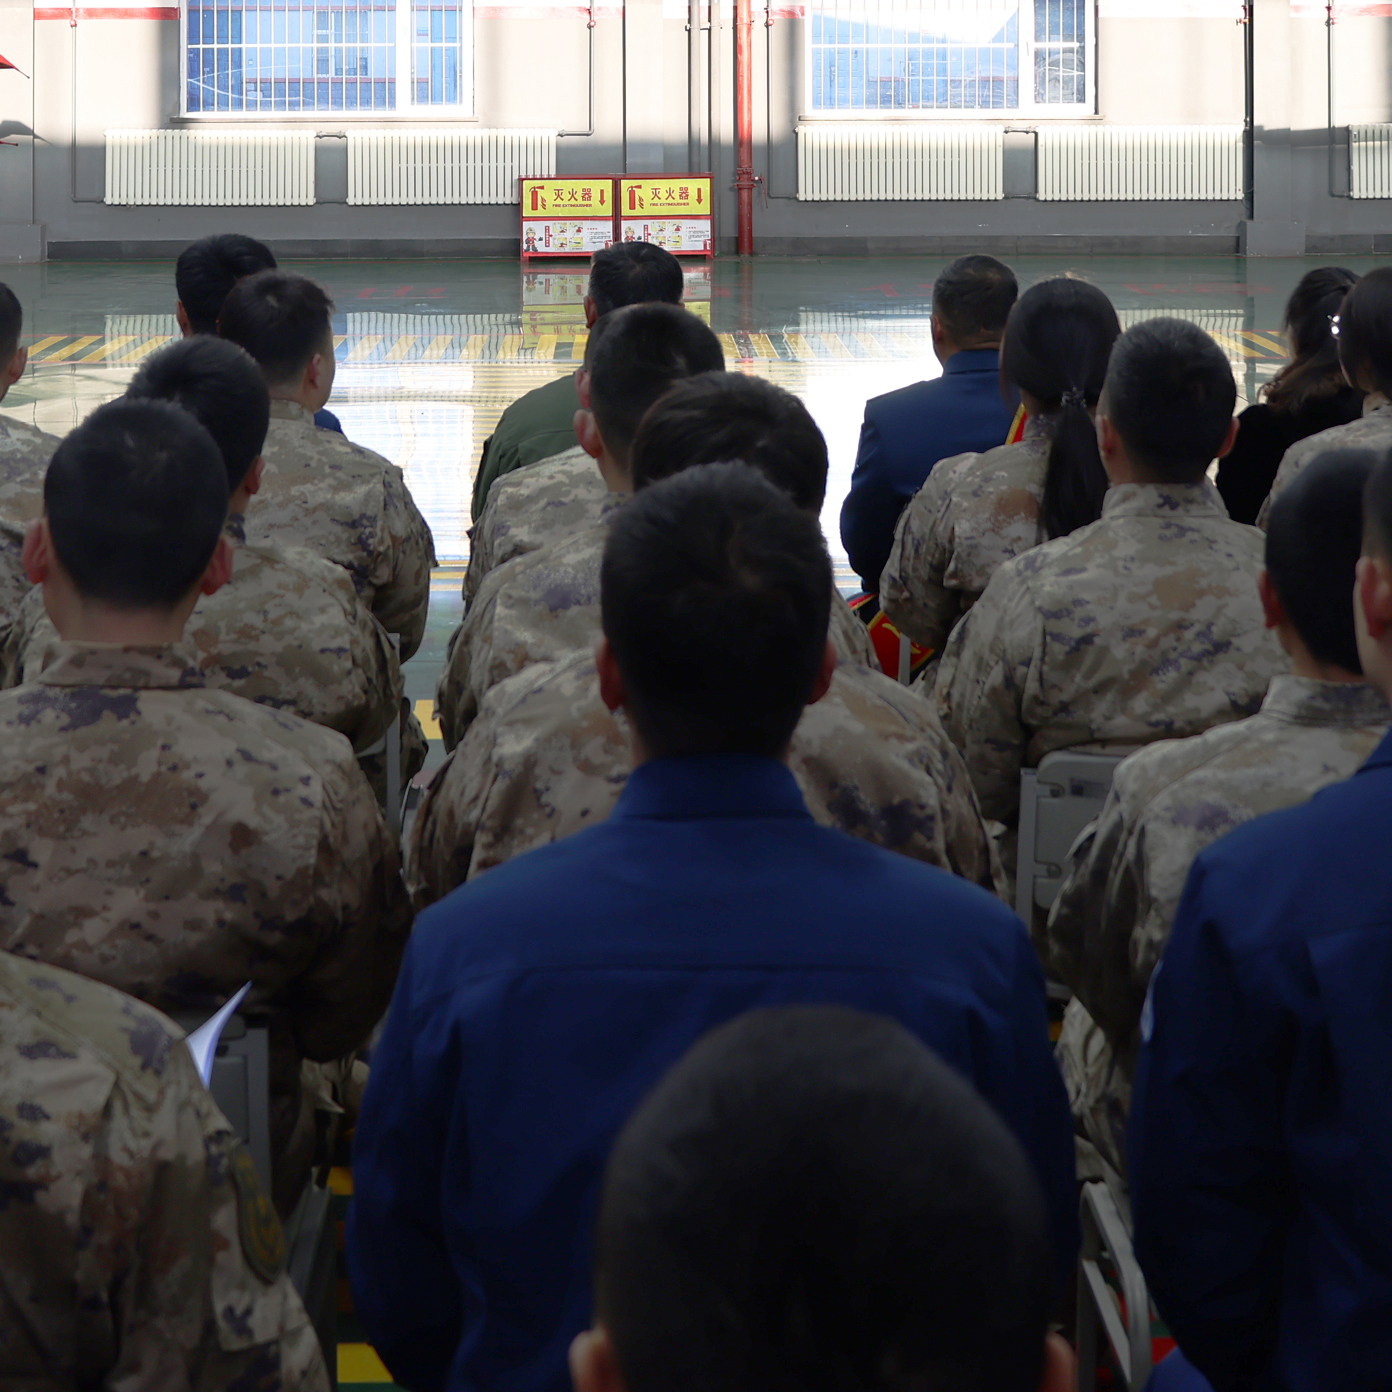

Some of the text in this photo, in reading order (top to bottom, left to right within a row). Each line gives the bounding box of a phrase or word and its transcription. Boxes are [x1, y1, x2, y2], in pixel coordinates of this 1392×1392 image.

[553, 187, 593, 202] 灭火器
[650, 186, 690, 201] 灭火器
